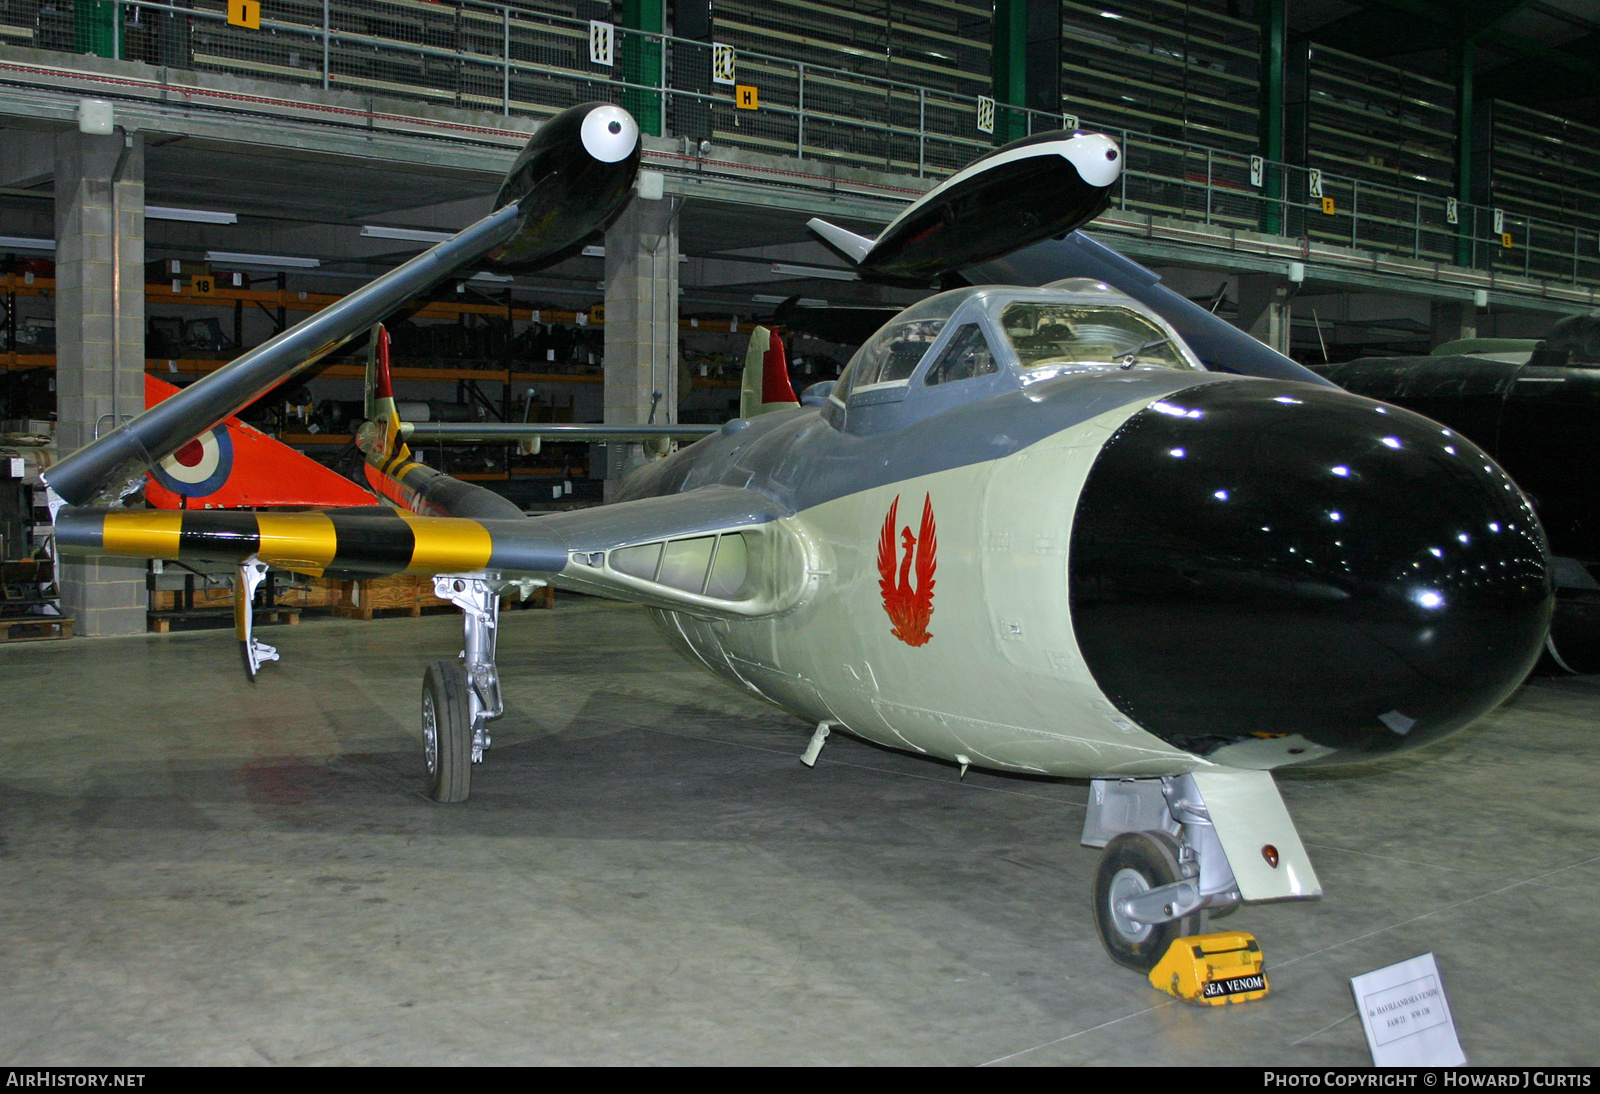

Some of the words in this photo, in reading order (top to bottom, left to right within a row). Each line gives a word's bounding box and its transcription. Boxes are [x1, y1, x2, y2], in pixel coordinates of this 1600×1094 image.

[716, 46, 735, 80] 10
[743, 91, 751, 105] H
[1326, 201, 1331, 211] F
[196, 280, 209, 292] 18
[1226, 976, 1262, 992] VENOM
[1376, 998, 1409, 1014] HAVILLAND
[1409, 995, 1419, 1004] SEA
